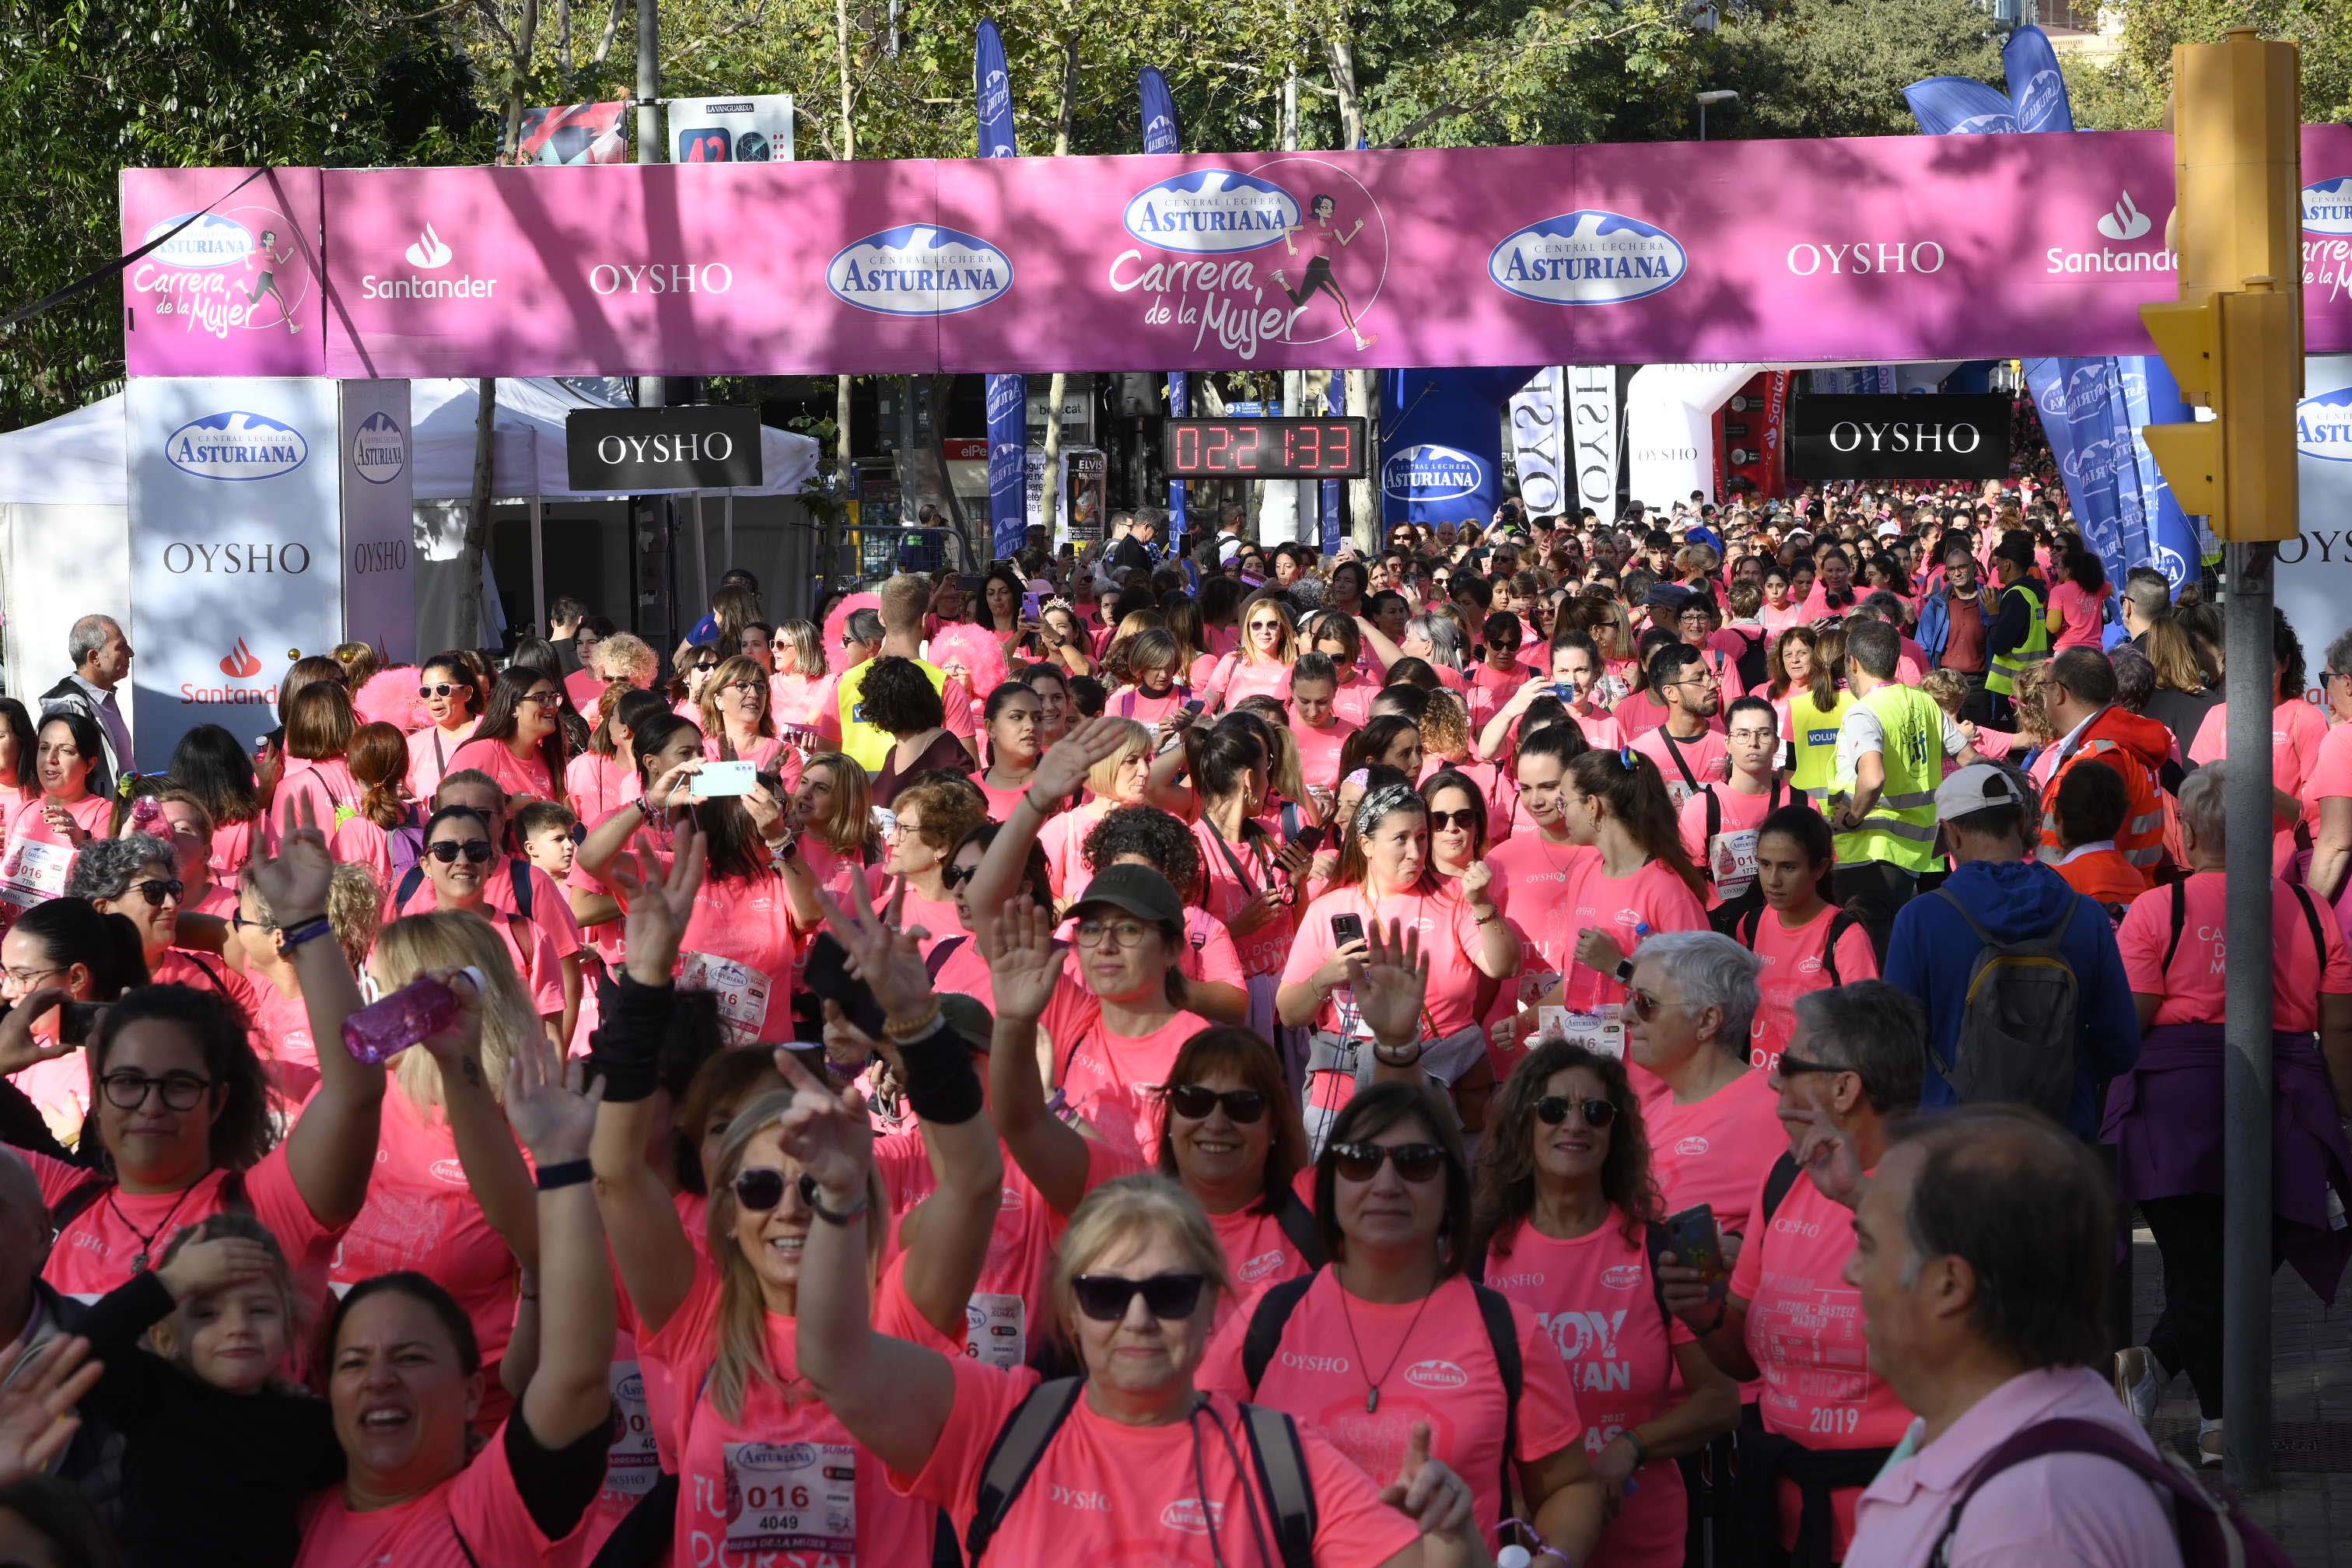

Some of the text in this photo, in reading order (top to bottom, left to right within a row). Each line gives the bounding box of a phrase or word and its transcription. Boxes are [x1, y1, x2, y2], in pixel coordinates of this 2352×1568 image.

[1164, 197, 1283, 207] CENTRAL LECHERA
[1139, 201, 1286, 232] ASTURIANA
[870, 254, 992, 265] CENTRAL LECHERA
[1535, 243, 1664, 253] CENTRAL LECHERA
[1787, 240, 1945, 276] OYSHO
[841, 258, 999, 292] ASTURIANA
[1108, 249, 1254, 292] Carrera
[1504, 247, 1671, 282] ASTURIANA
[133, 264, 225, 293] Carrera
[362, 274, 497, 300] Santander
[589, 262, 733, 296] OYSHO
[156, 292, 260, 338] de la Mujer
[1144, 287, 1308, 359] de la Mujer
[177, 437, 298, 464] ASTURIANA
[598, 432, 733, 466] OYSHO
[1176, 426, 1350, 470] 02:21:33
[1829, 421, 1980, 454] OYSHO
[357, 438, 402, 467] ASTURIANA
[1079, 460, 1103, 470] ELVIS
[1386, 467, 1475, 488] ASTURIANA
[163, 542, 310, 574] OYSHO
[355, 539, 406, 575] OYSHO
[180, 684, 278, 705] Santand
[21, 865, 42, 879] 016
[1524, 940, 1549, 959] TU
[1489, 1272, 1545, 1288] OYSHO
[1281, 1351, 1349, 1374] OYSHO
[1409, 1370, 1465, 1384] ASTURIANA
[1601, 1412, 1626, 1423] 2017
[1809, 1406, 1859, 1434] 2019
[744, 1450, 810, 1463] ASTURIANA
[693, 1473, 726, 1518] TU
[747, 1485, 810, 1508] 016
[759, 1515, 799, 1530] 4049
